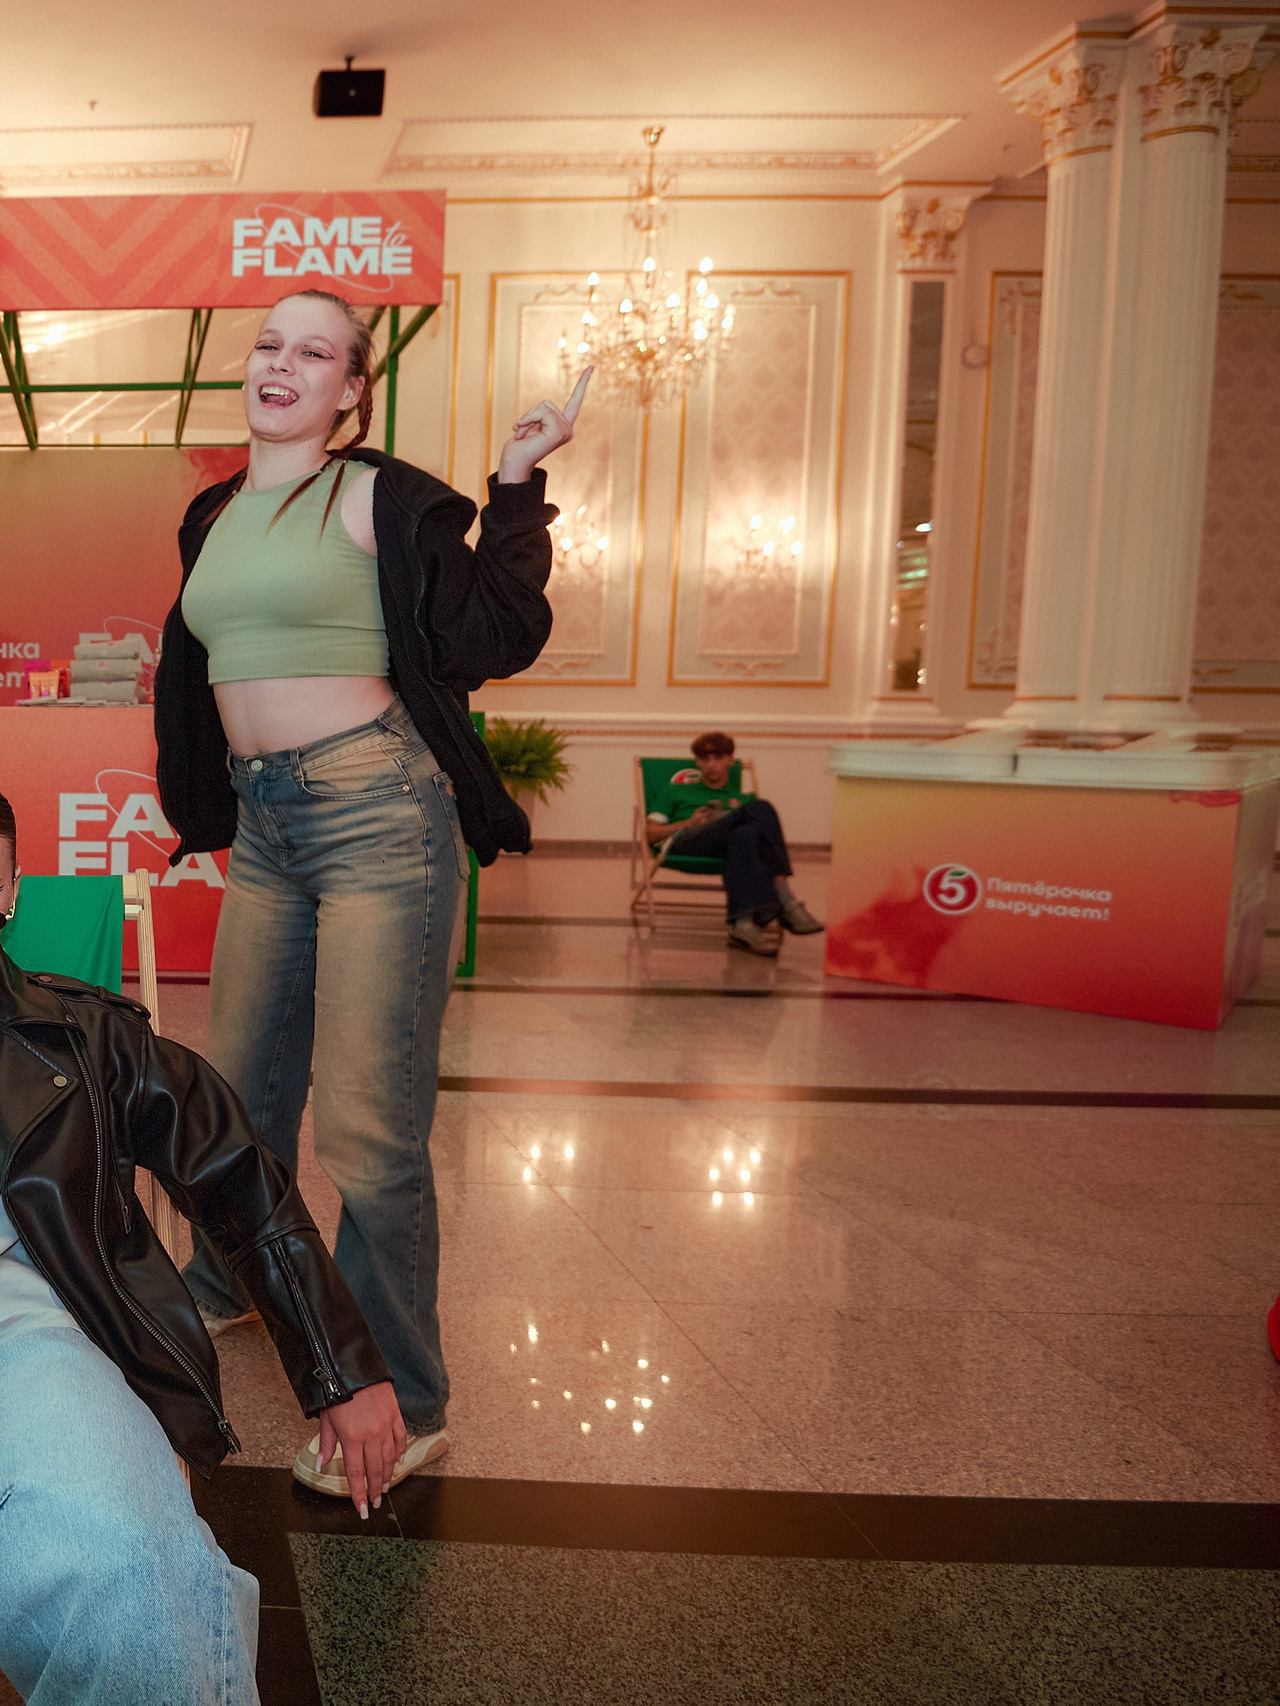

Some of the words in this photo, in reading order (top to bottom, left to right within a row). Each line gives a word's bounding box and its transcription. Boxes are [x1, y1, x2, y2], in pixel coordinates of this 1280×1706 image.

[233, 216, 382, 247] FAME
[383, 221, 411, 248] to
[232, 246, 412, 276] FLAME
[59, 792, 176, 839] FA
[58, 840, 227, 887] FLA
[986, 877, 1113, 902] Пятёрочка
[985, 897, 1110, 921] выручает!
